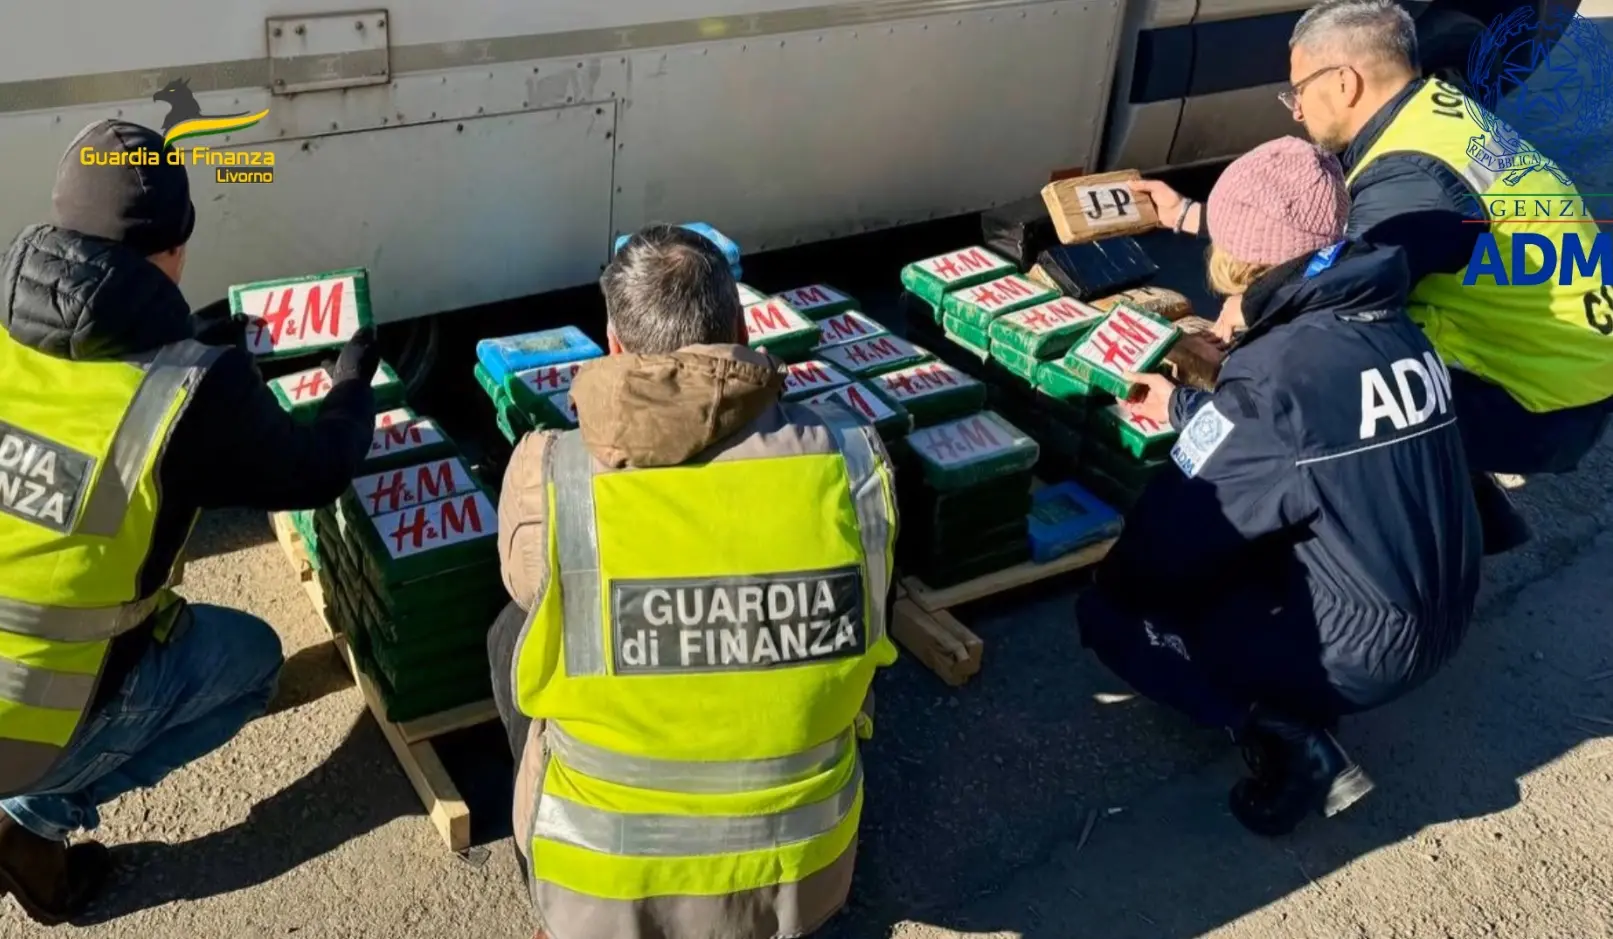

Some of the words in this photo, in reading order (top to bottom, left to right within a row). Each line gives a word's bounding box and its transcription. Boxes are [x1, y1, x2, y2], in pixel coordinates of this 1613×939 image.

[1087, 188, 1132, 221] J-P
[932, 249, 995, 279] H&M
[976, 276, 1035, 308] H&M
[255, 281, 344, 347] H&M
[1021, 301, 1088, 331] H&M
[844, 337, 902, 367] H&M
[1090, 310, 1160, 373] H&M
[289, 370, 331, 400] H&
[885, 363, 958, 396] H&M
[372, 422, 422, 451] &M
[925, 417, 1001, 461] H&M
[365, 461, 457, 513] H&M
[388, 496, 483, 552] H&M
[642, 579, 837, 627] GUARDIA
[622, 629, 660, 667] di
[679, 615, 858, 667] FINANZA
